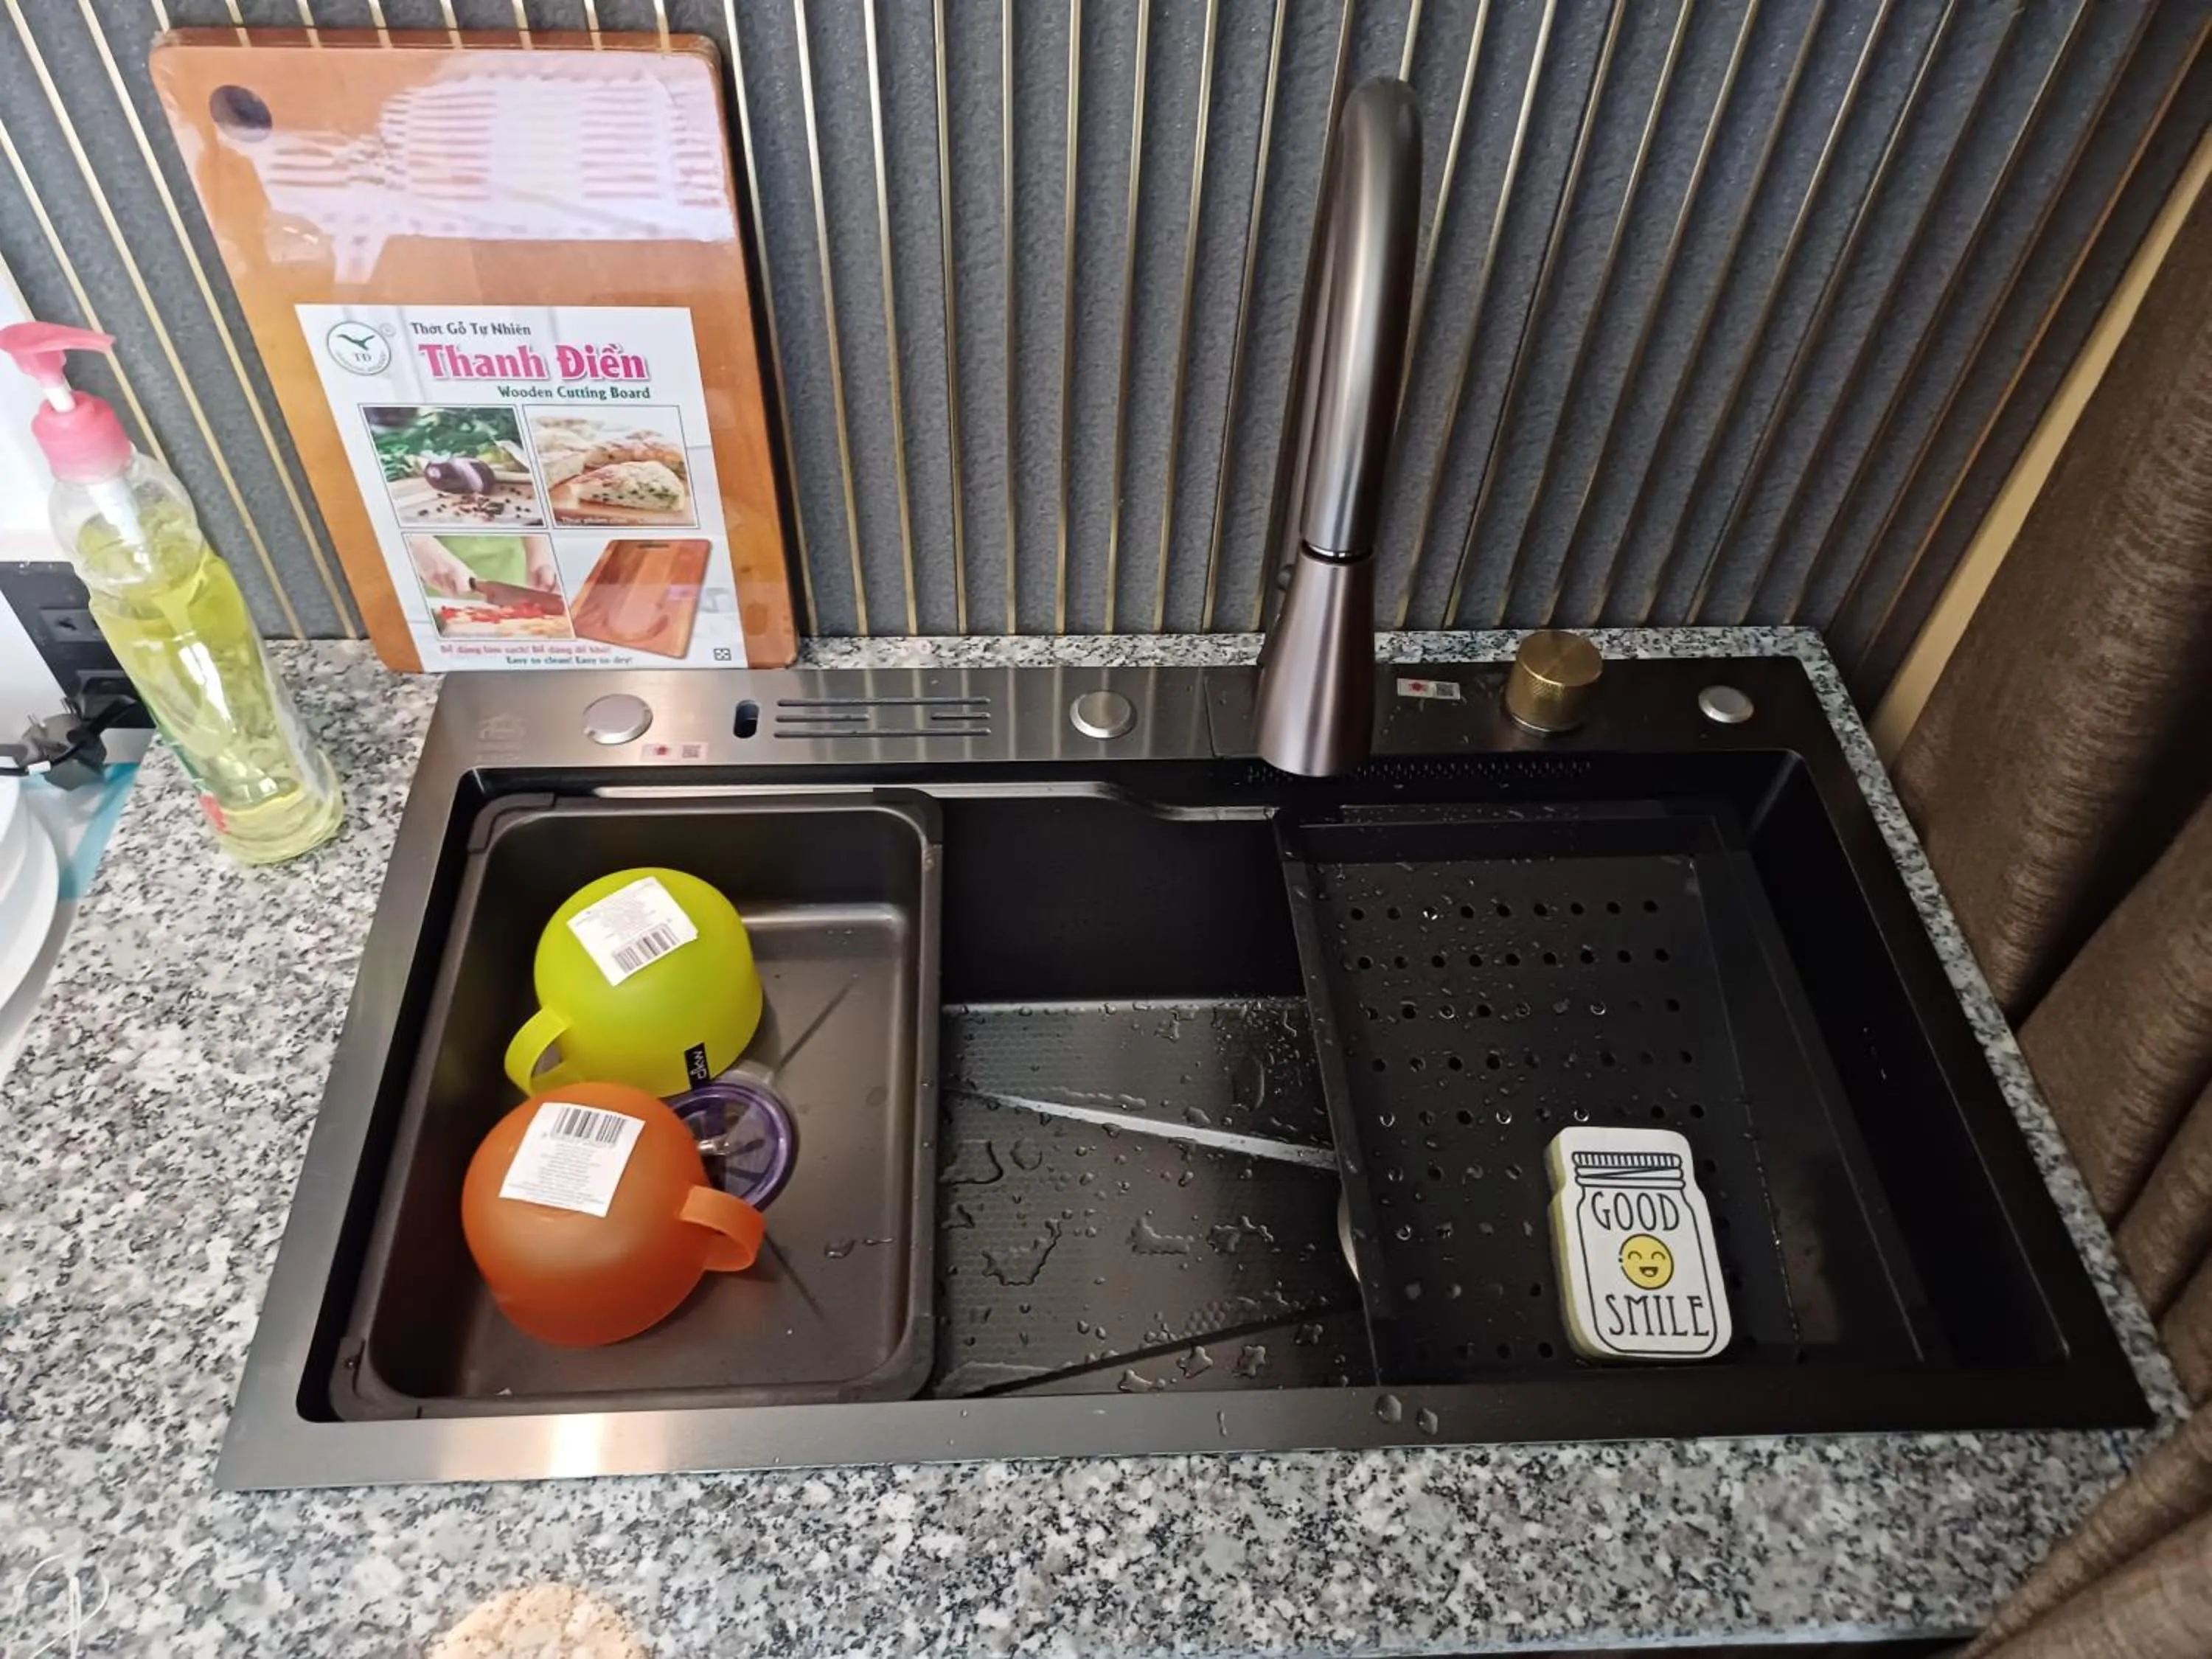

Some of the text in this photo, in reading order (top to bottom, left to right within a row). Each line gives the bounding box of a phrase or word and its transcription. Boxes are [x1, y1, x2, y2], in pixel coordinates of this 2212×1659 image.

[418, 343, 547, 378] Thanh
[556, 342, 647, 379] Điền
[498, 386, 650, 400] Wooden Cutting Board
[1590, 1192, 1680, 1231] GOOD
[1605, 1294, 1711, 1336] SMILE
